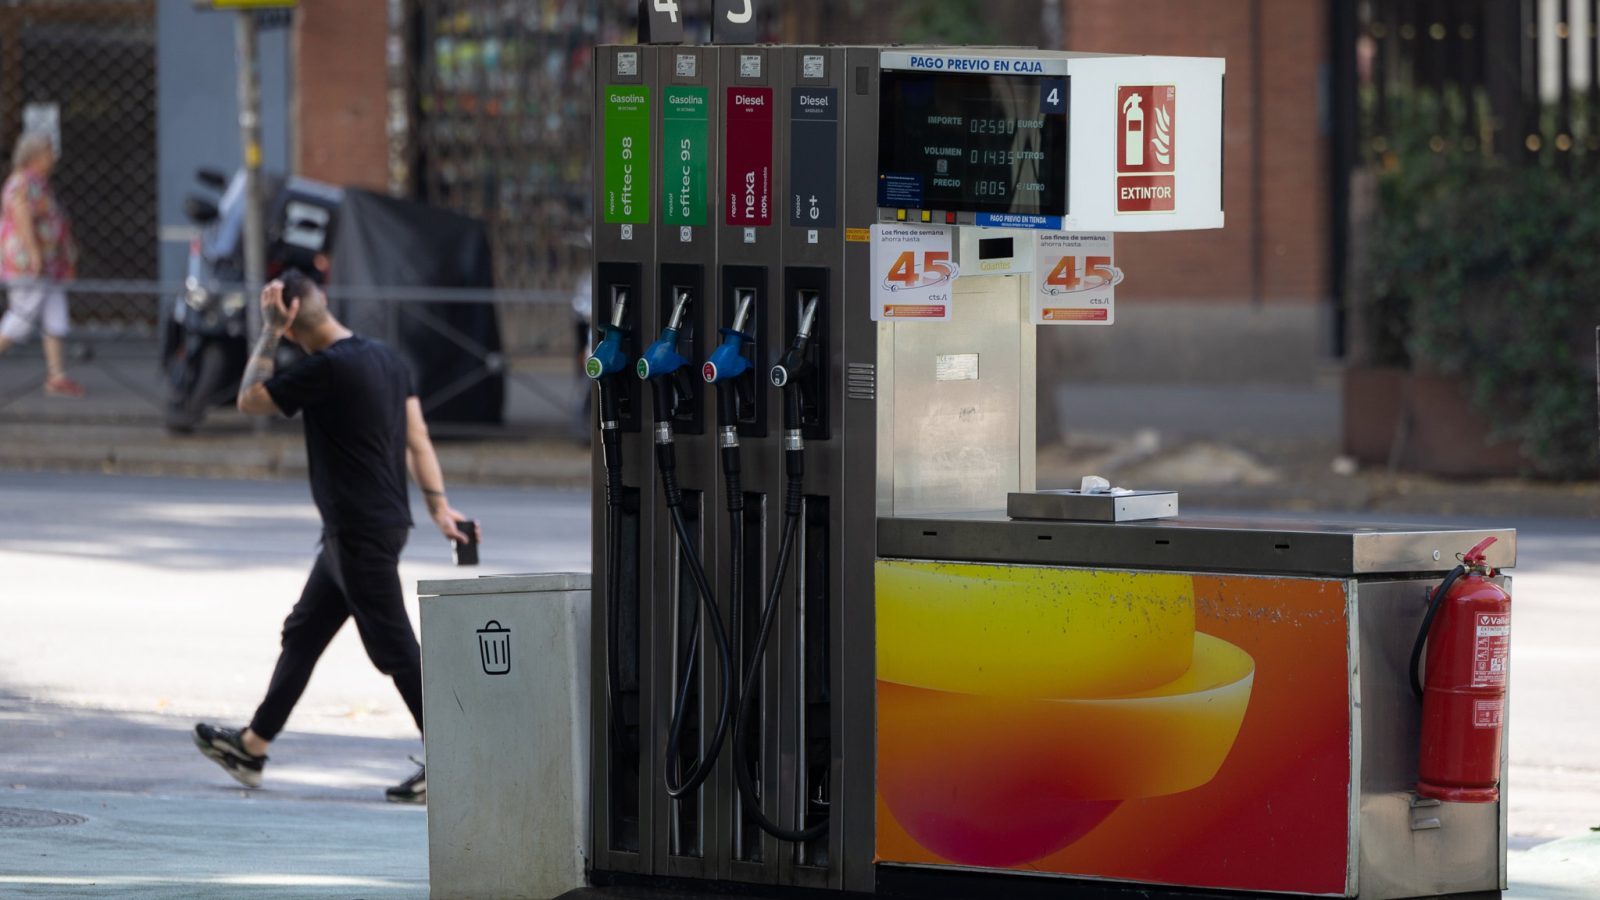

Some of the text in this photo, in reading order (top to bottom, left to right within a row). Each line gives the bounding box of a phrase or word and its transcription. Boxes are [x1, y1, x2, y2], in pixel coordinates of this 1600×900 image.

[910, 56, 1043, 73] PAGO PREVIO EN CAJA
[610, 94, 645, 104] Gasolina
[669, 95, 703, 105] Gasolina
[735, 95, 764, 106] Diesel
[800, 95, 829, 106] Diesel
[1046, 88, 1060, 106] 4
[927, 116, 963, 125] IMPORTE
[1017, 119, 1044, 128] EUROS
[924, 147, 962, 156] VOLUMEN
[1016, 151, 1044, 160] LITROS
[621, 136, 633, 216] efitec 98
[680, 138, 691, 217] efitec 95
[933, 178, 961, 187] PRECIO
[745, 171, 755, 219] nexa
[1121, 186, 1172, 200] EXTINTOR
[809, 194, 819, 220] e+
[990, 214, 1003, 222] PAGO
[1004, 215, 1020, 223] PREVIO
[1029, 216, 1047, 224] TIENDA
[887, 251, 951, 287] 45
[1047, 255, 1114, 290] 45
